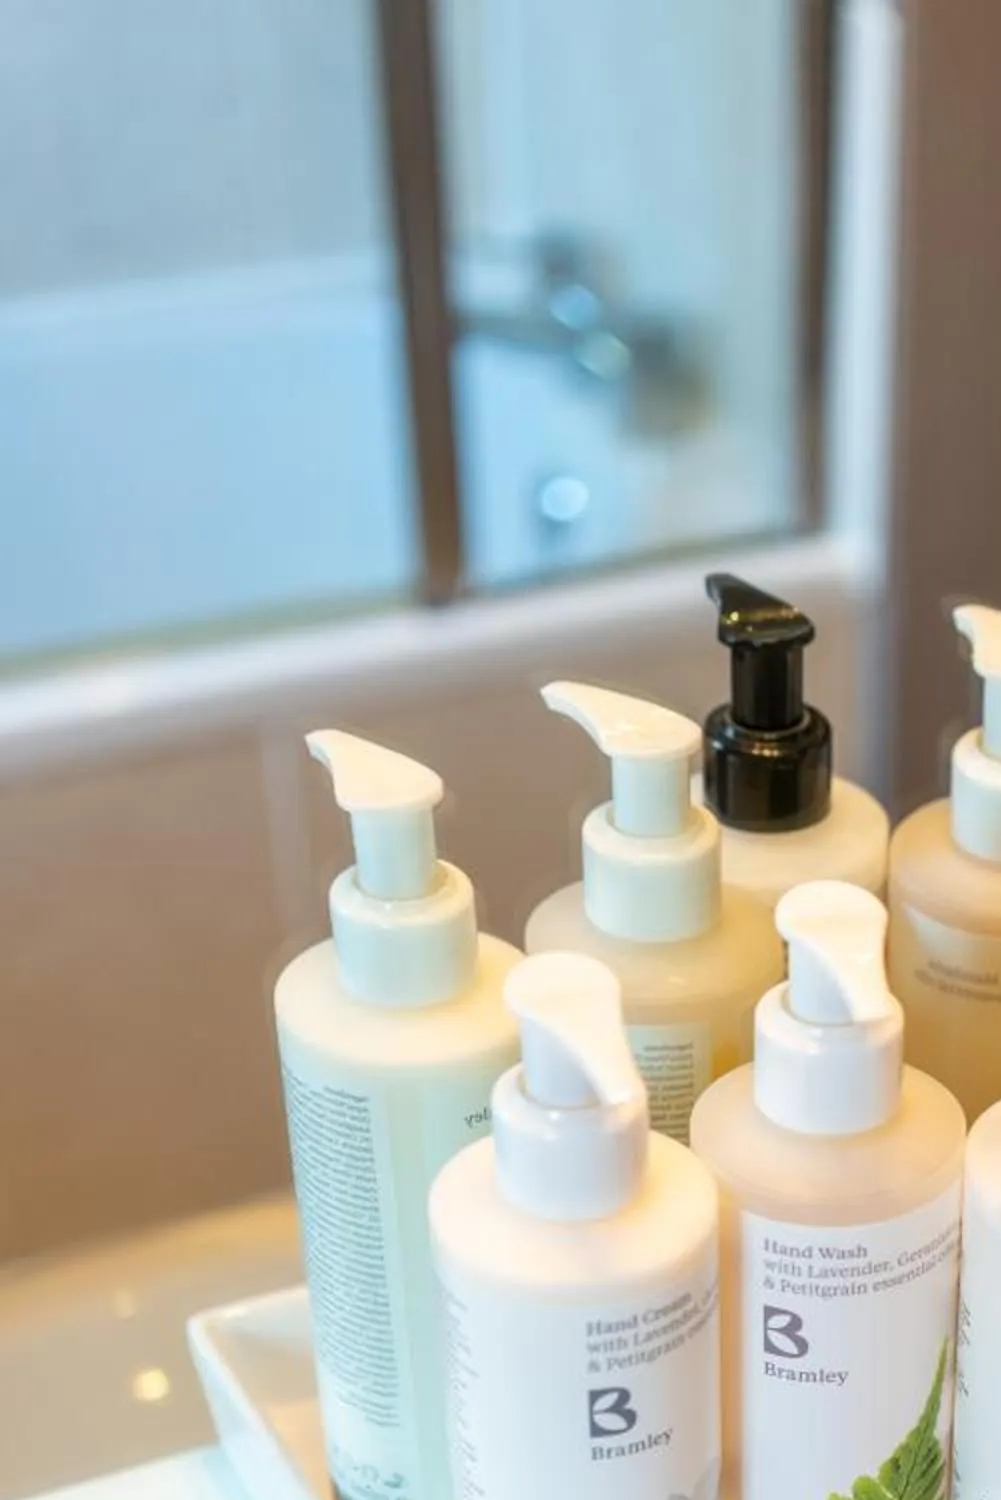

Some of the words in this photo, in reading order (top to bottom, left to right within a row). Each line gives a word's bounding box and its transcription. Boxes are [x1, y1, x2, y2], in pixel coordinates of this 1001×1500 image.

[764, 1238, 813, 1259] Hand
[818, 1245, 868, 1261] Wash
[764, 1259, 802, 1278] with
[808, 1261, 894, 1280] Lavender,
[763, 1276, 775, 1290] &
[781, 1279, 868, 1303] Petitgrain
[586, 1314, 638, 1338] Hand
[586, 1336, 628, 1354] with
[607, 1334, 685, 1372] Petitgrain
[764, 1361, 849, 1386] Bramley
[591, 1427, 674, 1461] Bramley
